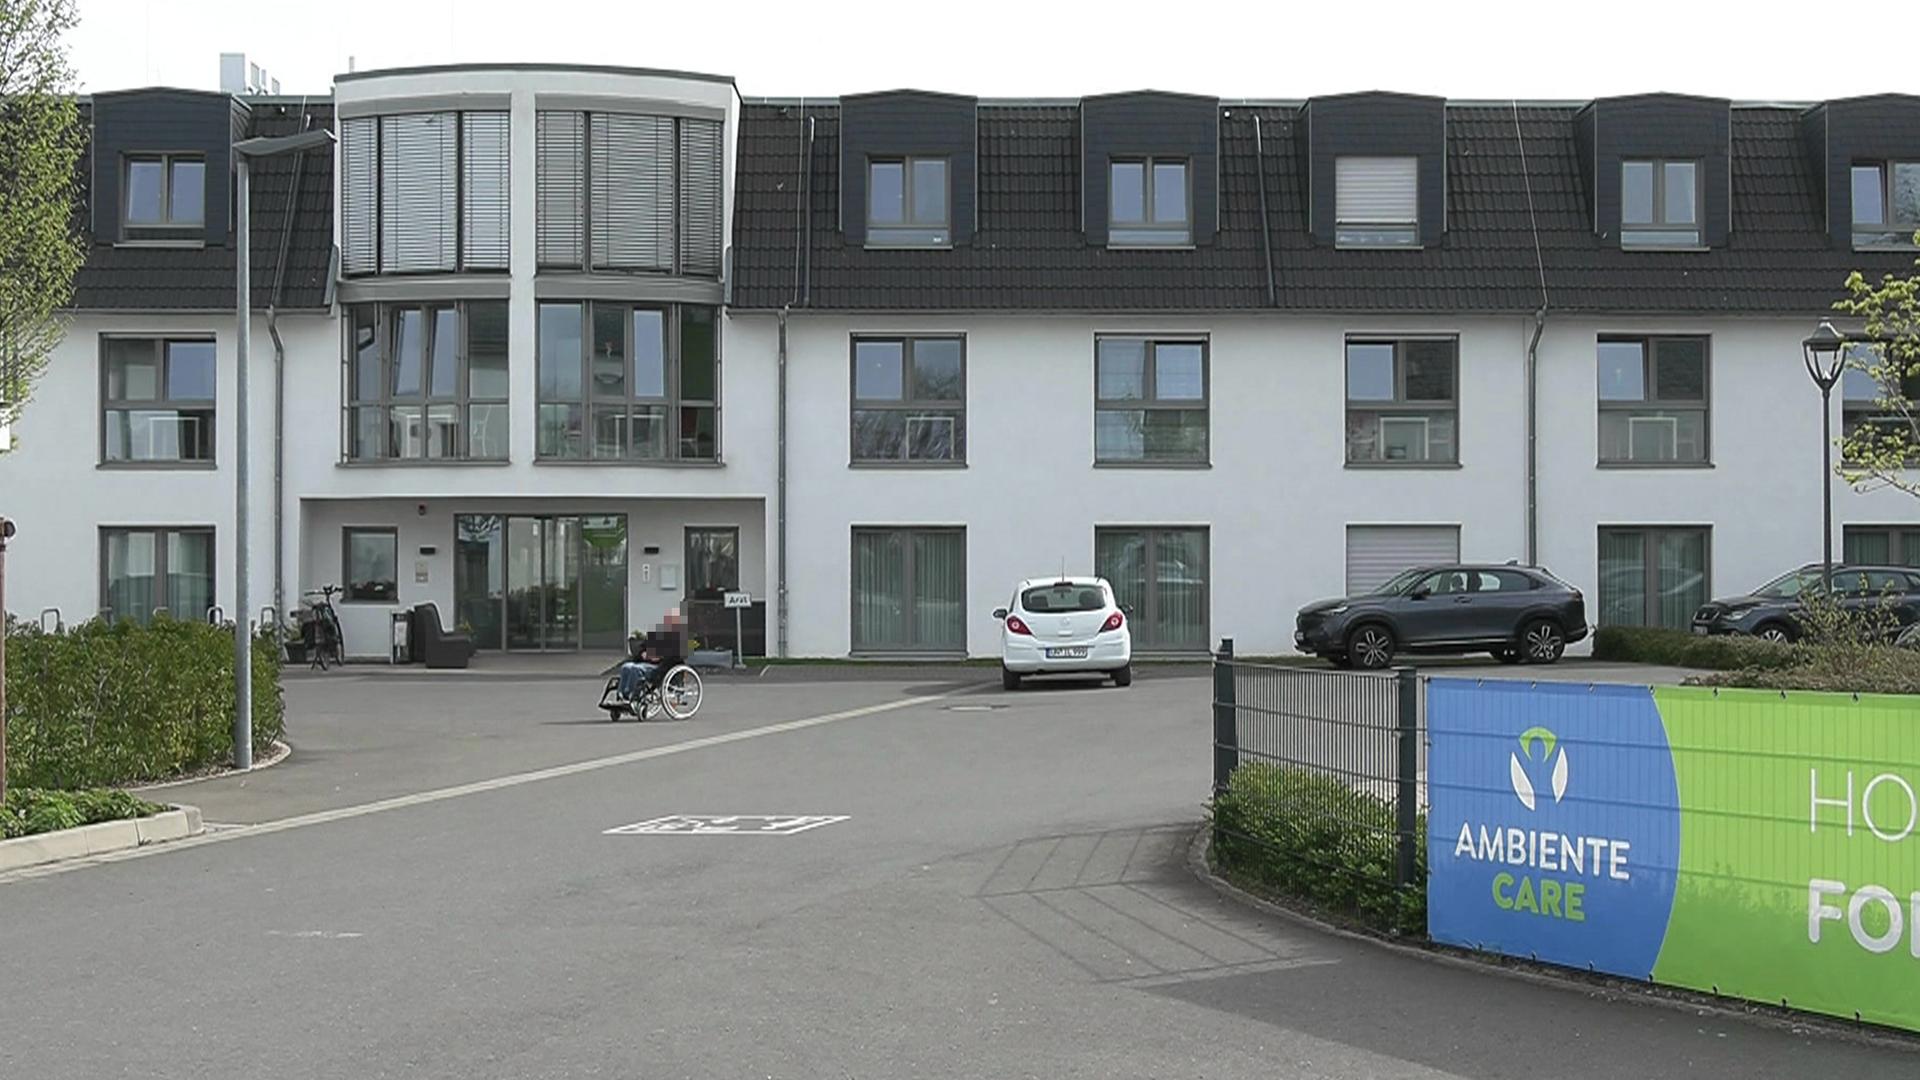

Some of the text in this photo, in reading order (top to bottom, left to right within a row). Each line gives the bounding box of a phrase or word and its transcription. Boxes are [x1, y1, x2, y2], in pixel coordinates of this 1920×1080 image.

[1810, 767, 1918, 842] HO
[1454, 822, 1631, 881] AMBIENTE
[1491, 871, 1585, 922] CARE
